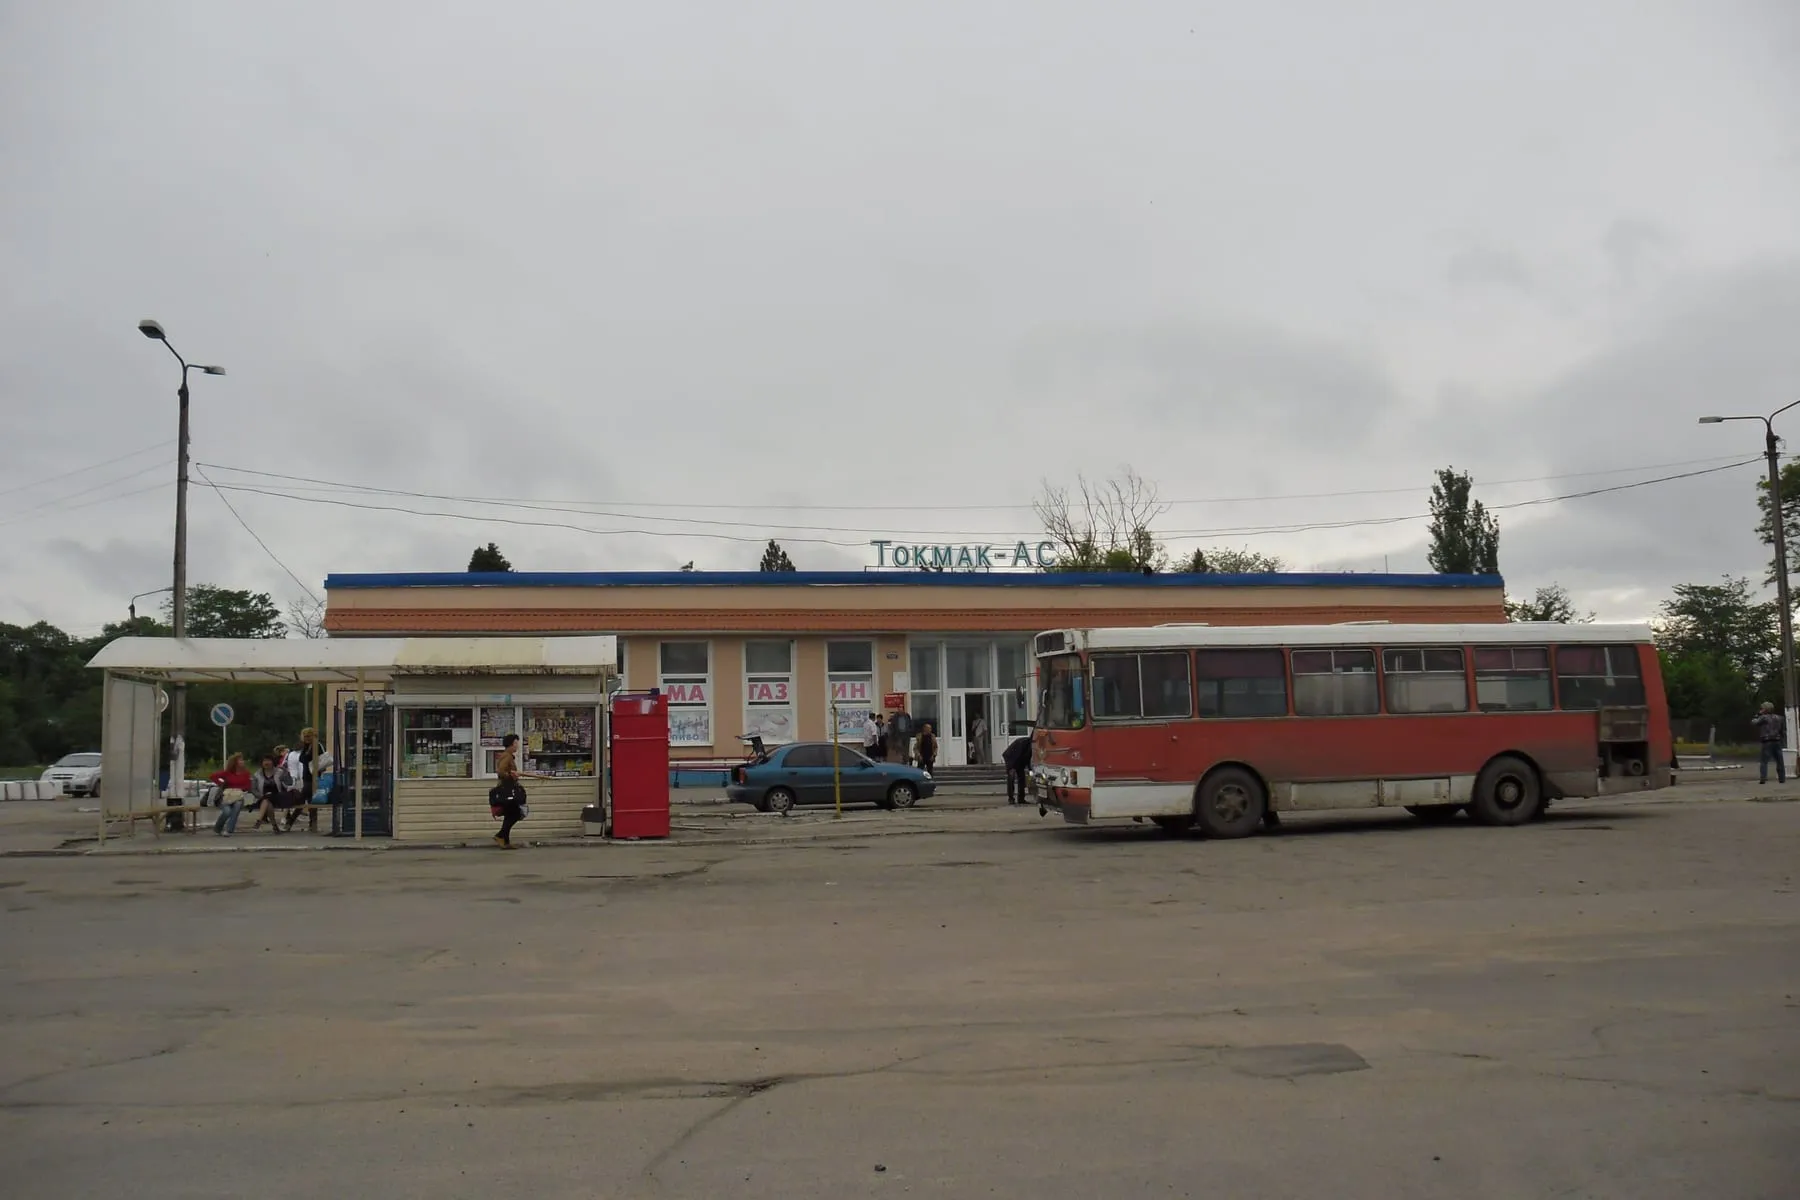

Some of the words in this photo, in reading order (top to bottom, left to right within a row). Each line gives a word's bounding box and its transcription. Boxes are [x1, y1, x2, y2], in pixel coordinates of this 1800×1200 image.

[667, 684, 705, 701] МА
[748, 683, 788, 700] ГАЗ
[831, 682, 865, 699] ИН
